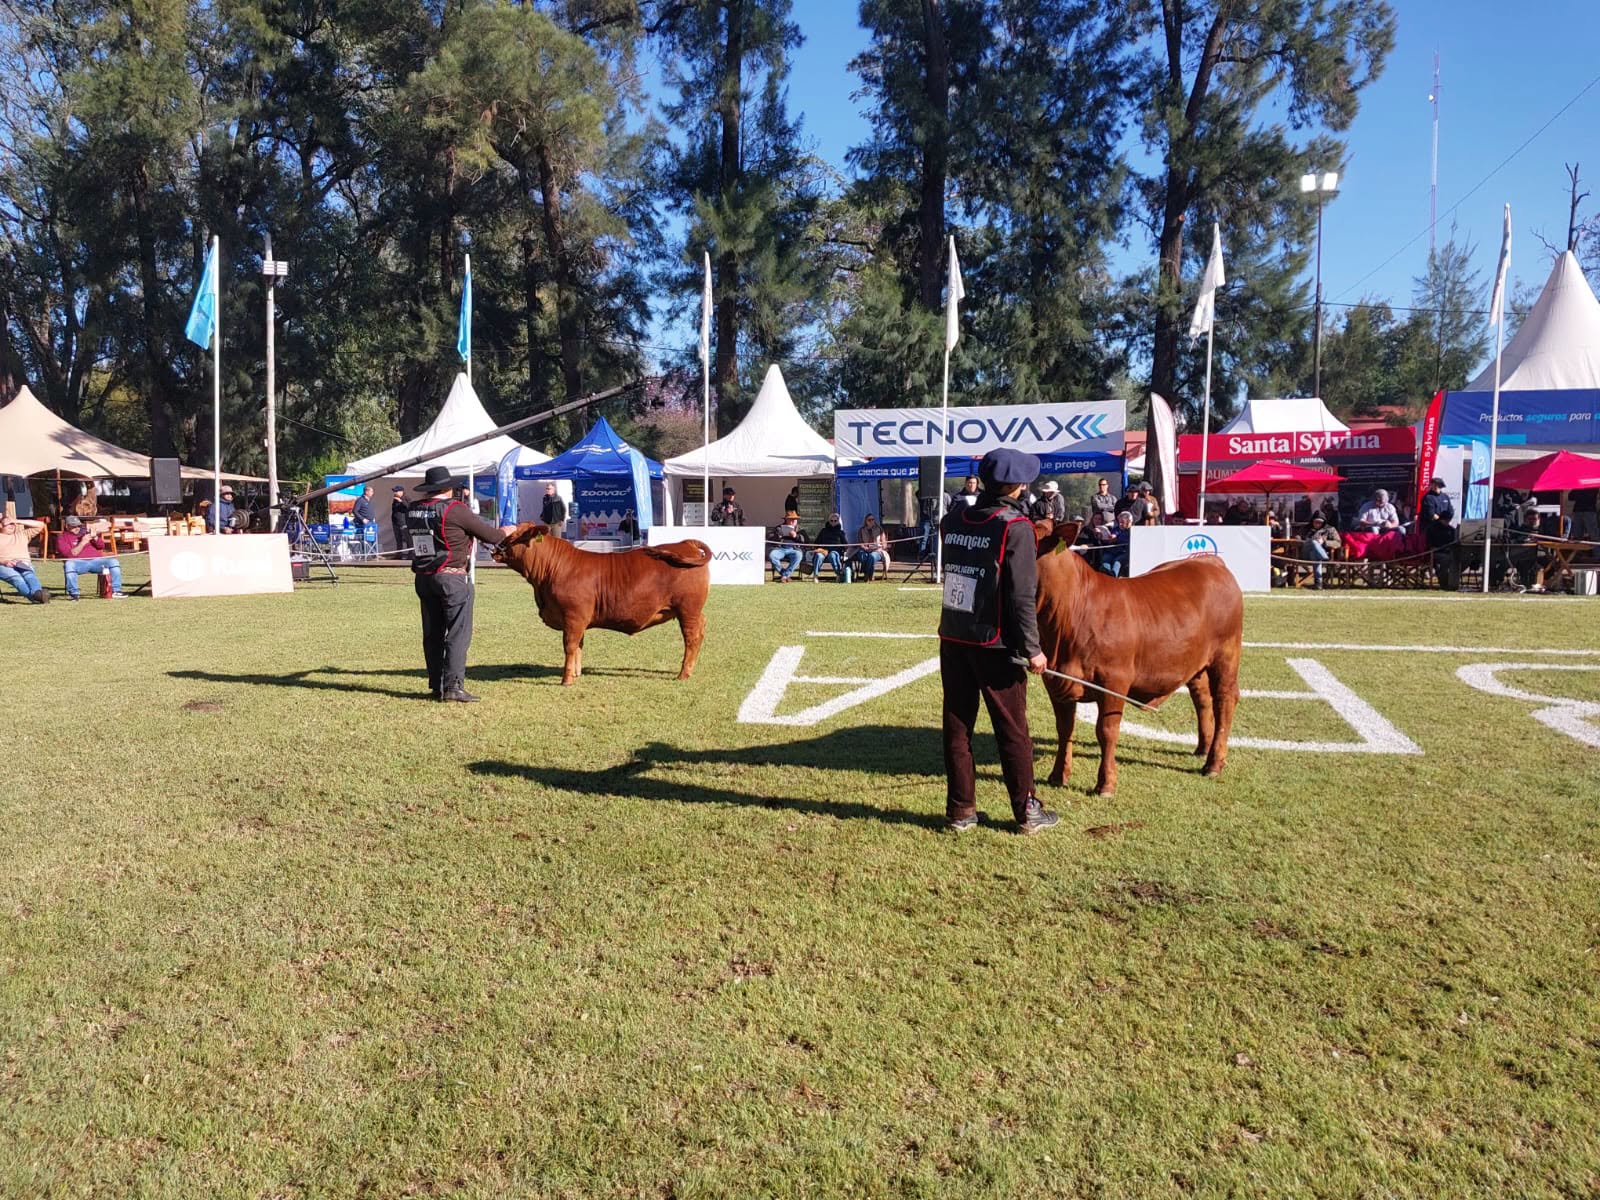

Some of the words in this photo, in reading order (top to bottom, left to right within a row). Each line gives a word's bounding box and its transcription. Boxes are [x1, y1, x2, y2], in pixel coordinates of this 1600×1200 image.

[1569, 412, 1592, 423] para
[848, 415, 1084, 446] TECNOVAX
[1228, 436, 1290, 456] Santa
[1299, 432, 1381, 456] Sylvina
[857, 467, 889, 477] ciencia
[890, 467, 908, 477] que
[1040, 460, 1053, 470] ue
[1054, 459, 1097, 471] protege
[1420, 461, 1431, 491] Santa
[951, 588, 964, 605] 50
